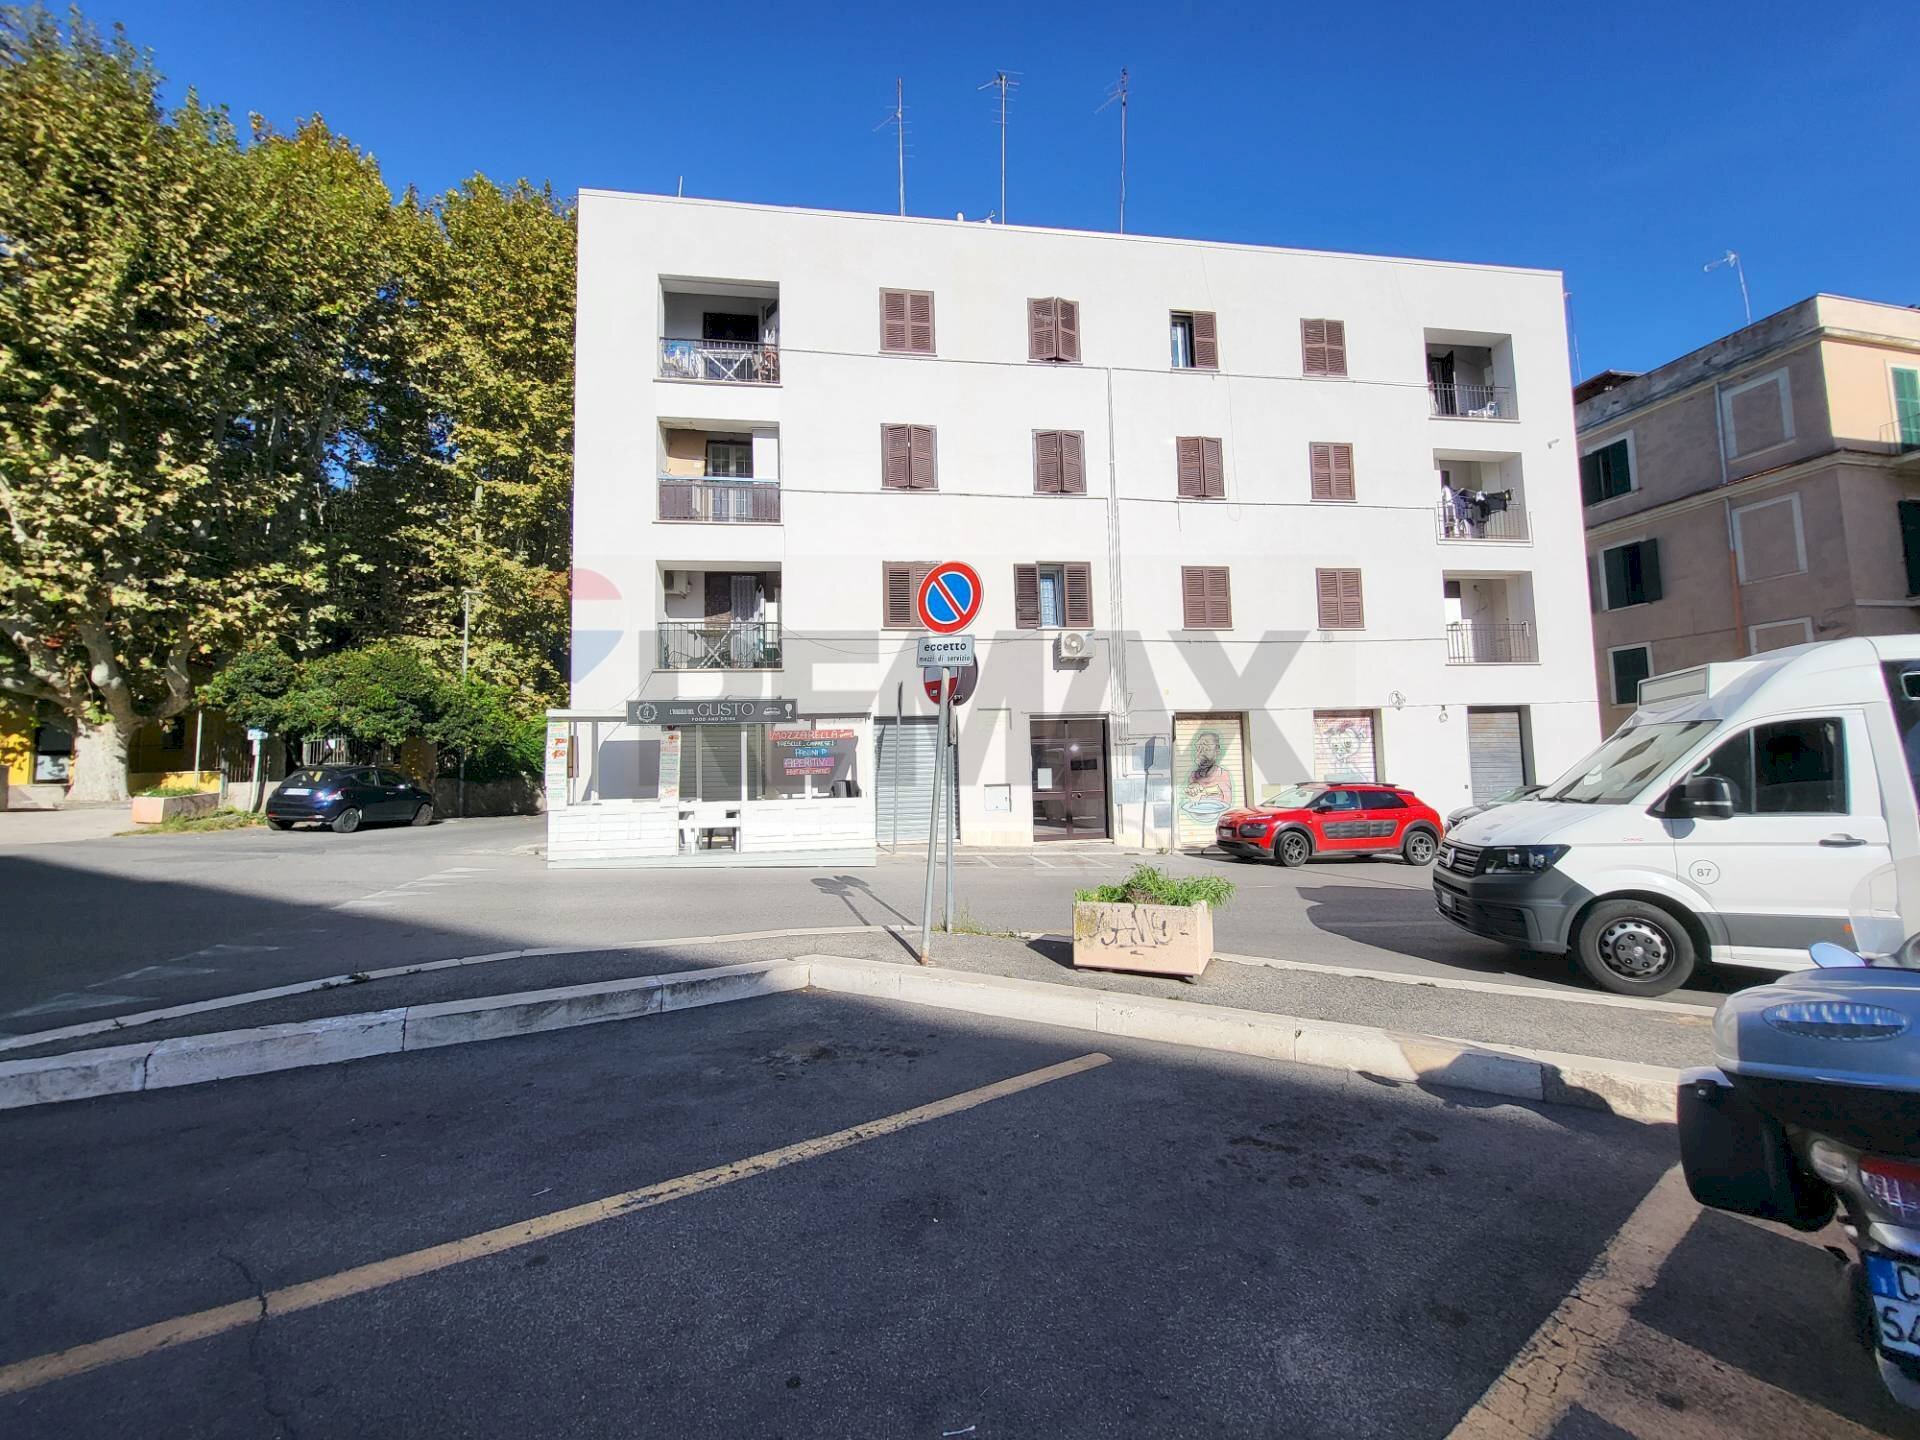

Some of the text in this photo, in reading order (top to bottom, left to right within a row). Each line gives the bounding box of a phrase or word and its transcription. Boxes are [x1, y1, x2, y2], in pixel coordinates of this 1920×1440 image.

[924, 642, 967, 652] eccetto
[937, 654, 944, 662] di
[947, 654, 971, 662] servizio
[697, 702, 755, 716] GUSTO
[1696, 868, 1712, 877] 87
